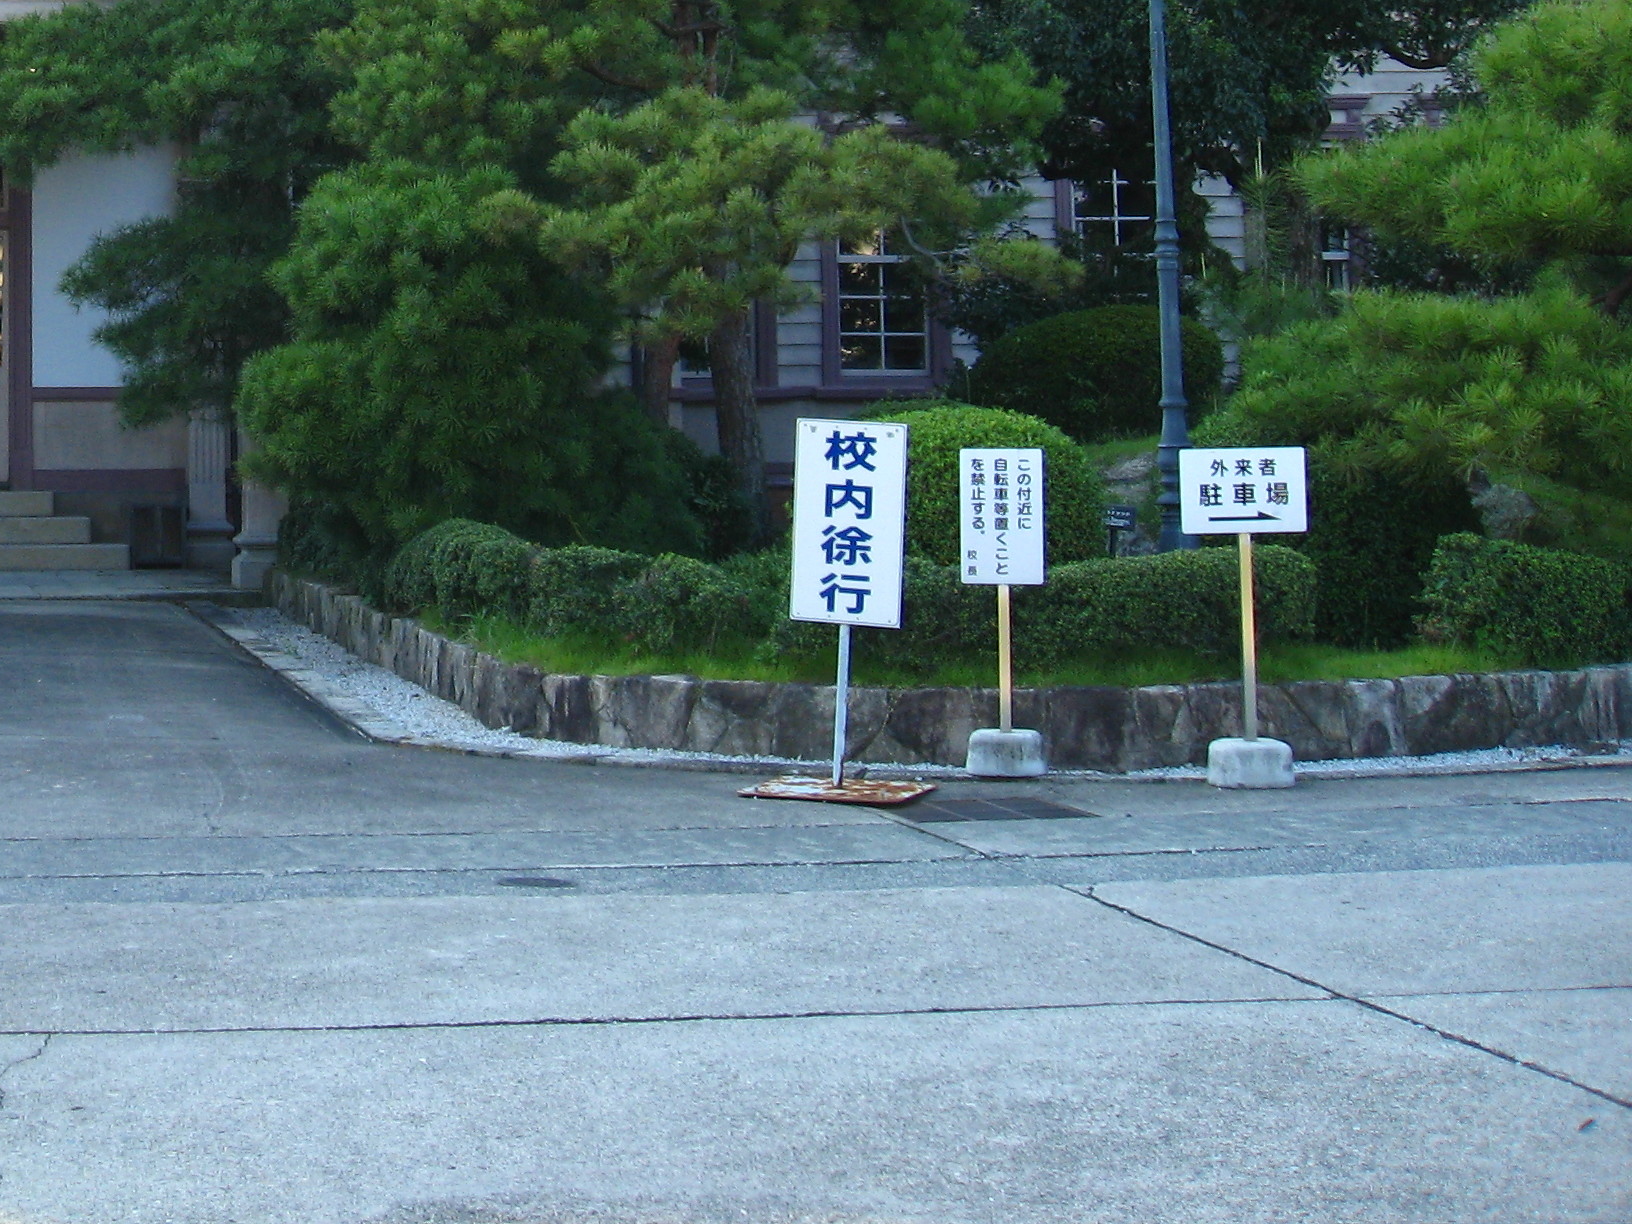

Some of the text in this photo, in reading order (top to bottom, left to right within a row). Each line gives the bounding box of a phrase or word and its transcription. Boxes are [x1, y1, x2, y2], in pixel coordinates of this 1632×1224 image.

[970, 458, 986, 535] を禁止する。
[1017, 458, 1032, 530] この付近に
[1199, 482, 1289, 506] 駐車場
[1210, 458, 1277, 478] 外来者
[818, 431, 877, 615] 校内徐行
[994, 458, 1009, 575] 自転車等置くこと
